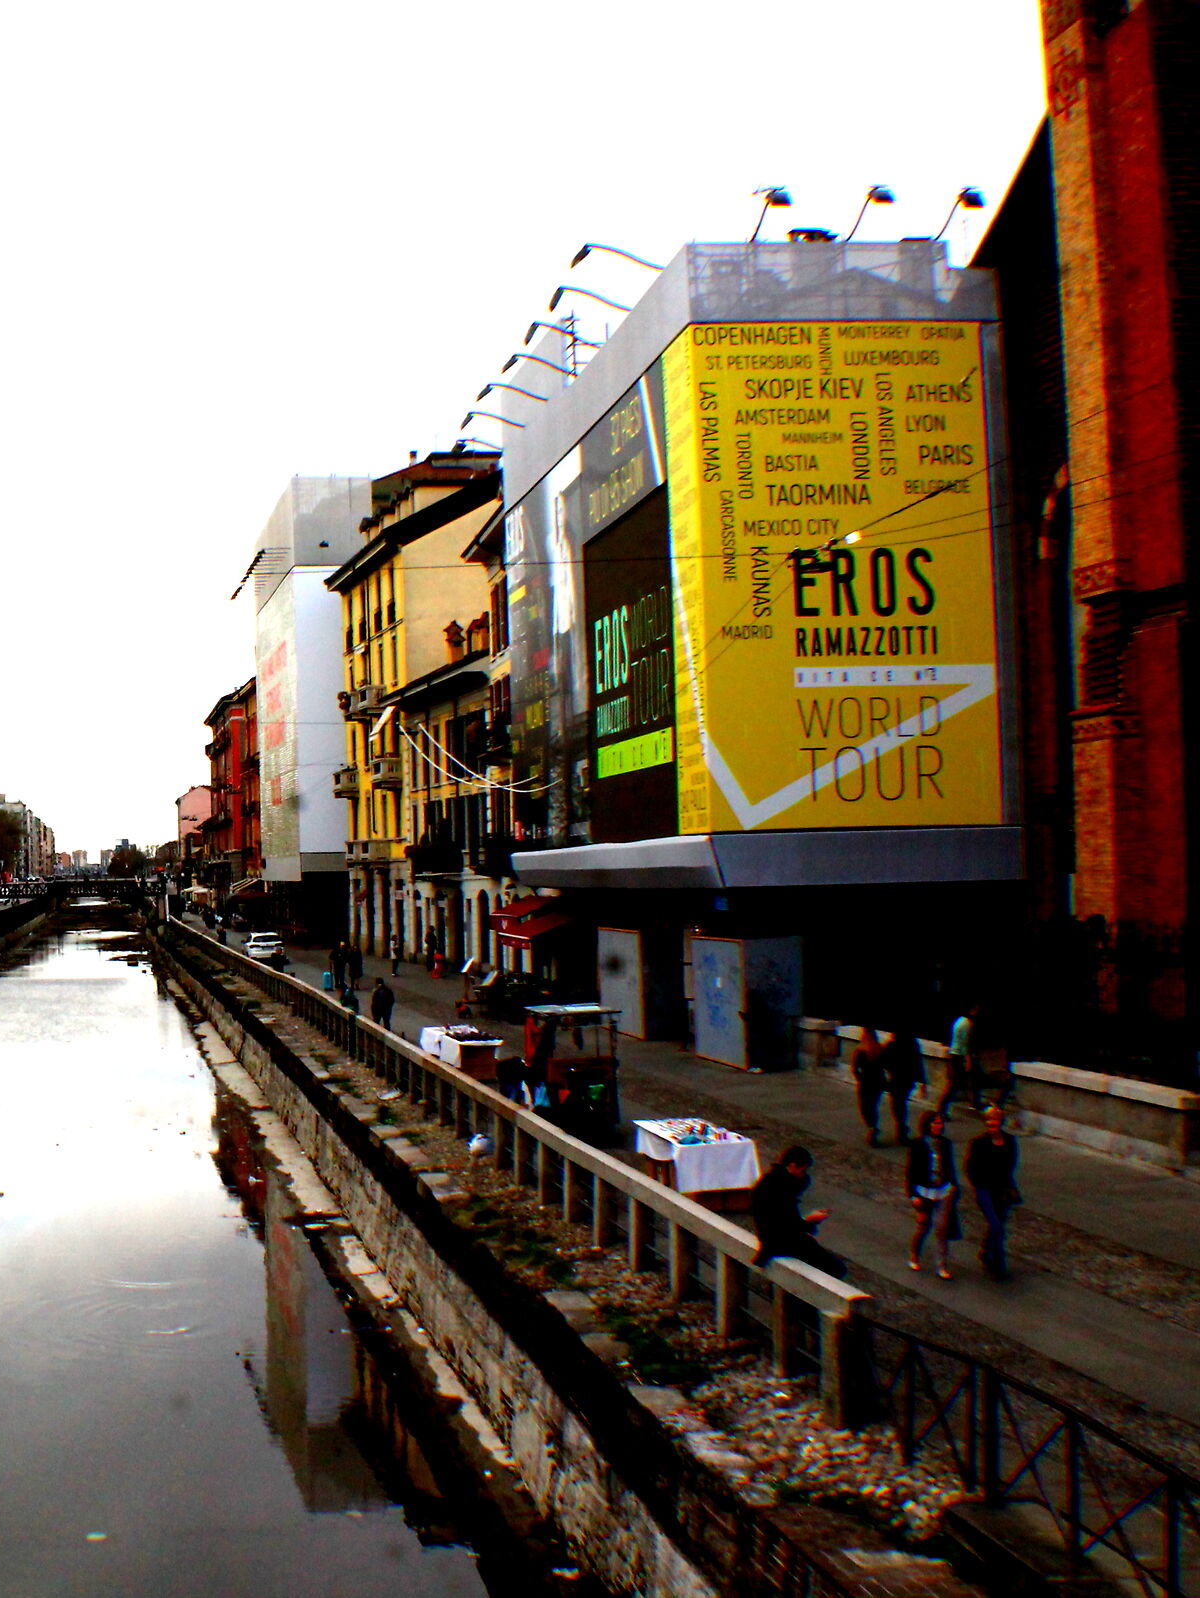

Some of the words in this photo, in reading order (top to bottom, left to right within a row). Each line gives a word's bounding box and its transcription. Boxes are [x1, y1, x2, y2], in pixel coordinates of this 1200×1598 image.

[694, 327, 811, 346] COPENHAGEN
[837, 326, 910, 339] MONTERREY
[706, 356, 722, 370] ST.
[727, 355, 812, 370] PETERSBURG
[818, 327, 833, 376] MUNICH
[844, 350, 940, 366] LUXEMBOURG
[699, 382, 717, 411] LAS
[745, 379, 813, 400] SKOPJE
[820, 378, 864, 399] KIEV
[876, 373, 893, 402] LOS
[906, 384, 974, 403] ATHENS
[735, 409, 831, 425] AMSTERDAM
[906, 415, 946, 432] LYON
[701, 417, 721, 483] PALMAS
[782, 433, 843, 444] MANNHEIM
[850, 412, 870, 480] LONDON
[877, 407, 896, 476] ANGELES
[736, 432, 755, 499] TORONTO
[765, 455, 819, 472] BASTIA
[919, 445, 974, 466] PARIS
[766, 484, 870, 505] TAORMINA
[905, 480, 972, 495] BELGRADE
[720, 491, 738, 582] CARCASSONNE
[743, 521, 803, 536] MEXICO
[807, 519, 839, 535] CITY
[750, 546, 772, 617] KAUNAS
[792, 548, 935, 617] EROS
[631, 585, 668, 652] WORLD
[722, 625, 773, 640] MADRID
[594, 605, 629, 694] EROS
[795, 626, 939, 657] RAMAZZOTTI
[631, 649, 671, 728] TOUR
[796, 696, 942, 739] WORLD
[800, 746, 944, 802] TOUR
